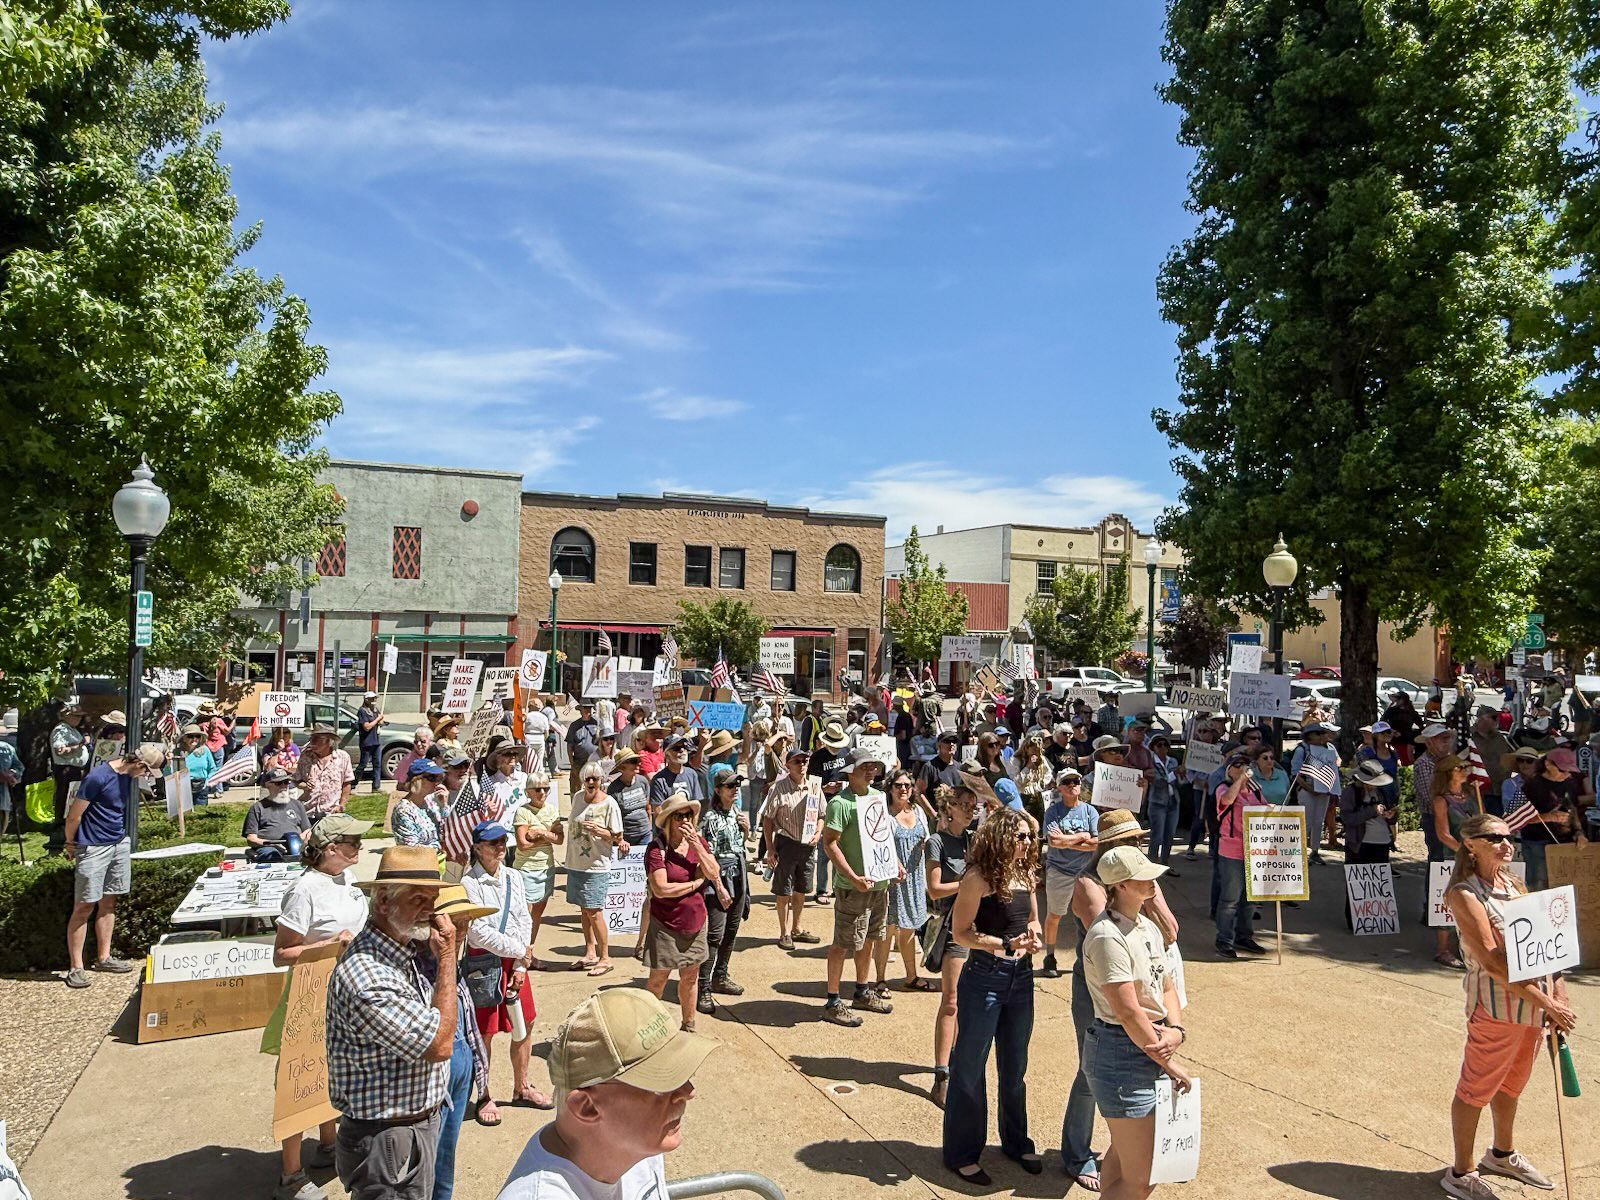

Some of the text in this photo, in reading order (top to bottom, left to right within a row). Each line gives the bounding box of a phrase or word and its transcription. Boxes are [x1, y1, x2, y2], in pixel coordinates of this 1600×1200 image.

[1524, 633, 1541, 645] 89
[454, 665, 475, 674] MAKE
[485, 670, 496, 680] NO
[452, 676, 473, 685] NAZIS
[264, 693, 300, 702] FREEDOM
[452, 688, 467, 697] BAD
[446, 699, 468, 708] AGAIN
[1172, 689, 1221, 709] NO FASCISM
[270, 716, 284, 725] NOT
[286, 717, 302, 725] FREE
[476, 719, 491, 729] OFF
[822, 757, 846, 772] RESIST
[1099, 766, 1113, 781] We
[1249, 823, 1253, 831] I
[1278, 823, 1300, 831] KNOW
[872, 845, 891, 866] NO
[1250, 848, 1302, 856] GOLDEN YEARS
[1255, 861, 1296, 869] OPPOSING
[1262, 874, 1303, 882] DICTATOR
[1347, 863, 1388, 883] MAKE
[1350, 881, 1392, 901] LYING
[1352, 899, 1397, 918] WRONG
[1355, 916, 1396, 936] AGAIN
[1508, 917, 1569, 972] PEACE
[162, 947, 272, 971] LOSS OF CHOICE
[293, 1074, 325, 1103] back
